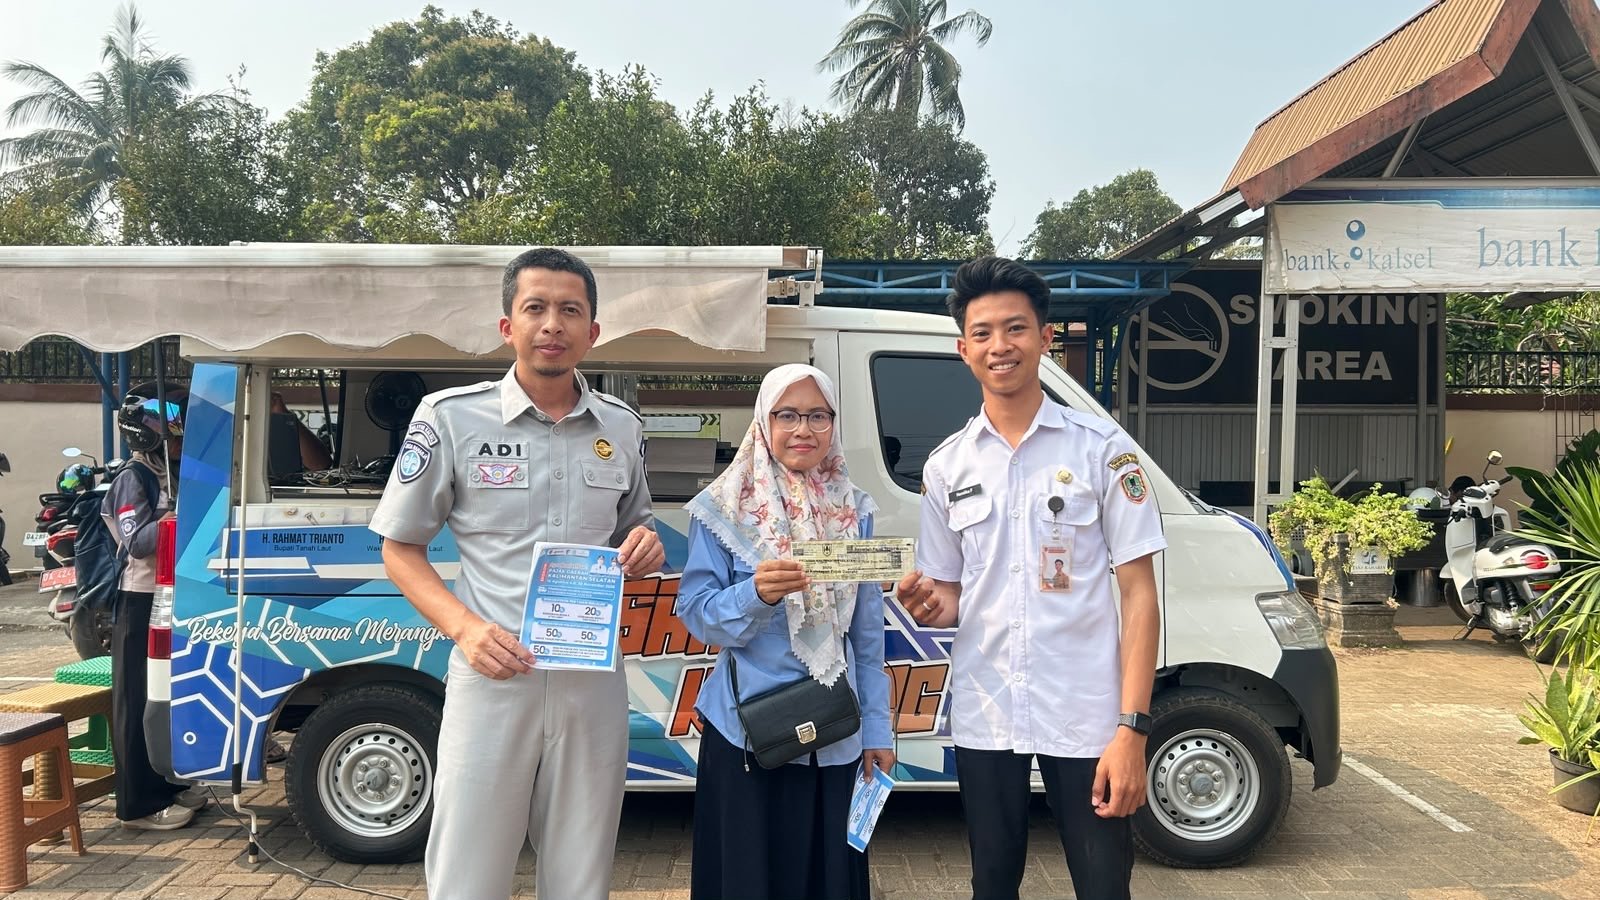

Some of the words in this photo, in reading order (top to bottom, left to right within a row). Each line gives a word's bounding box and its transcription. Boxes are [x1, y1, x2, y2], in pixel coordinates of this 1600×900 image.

[1284, 248, 1342, 271] bank
[1368, 246, 1434, 270] kalsel
[1476, 226, 1581, 268] bank
[478, 442, 522, 457] ADI
[262, 533, 271, 544] H.
[273, 533, 307, 544] RAHMAT
[309, 533, 344, 544] TRIANTO
[267, 616, 352, 643] Bersama
